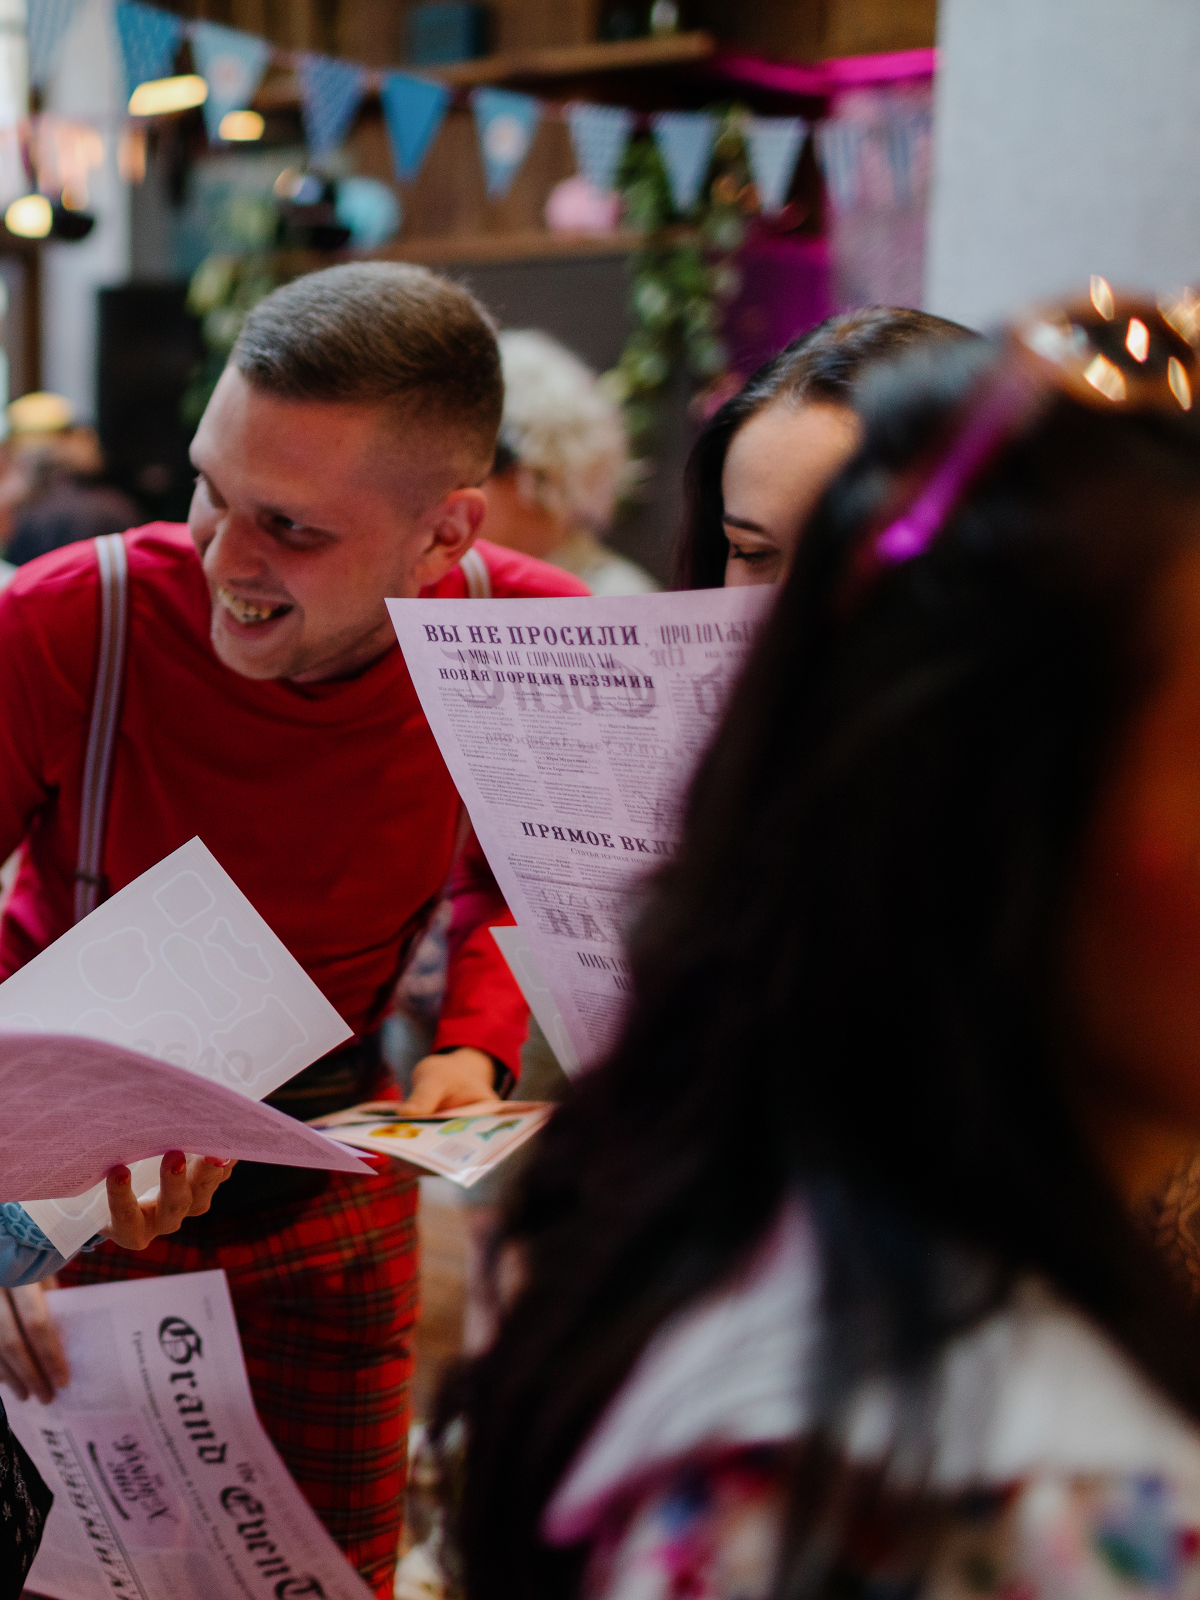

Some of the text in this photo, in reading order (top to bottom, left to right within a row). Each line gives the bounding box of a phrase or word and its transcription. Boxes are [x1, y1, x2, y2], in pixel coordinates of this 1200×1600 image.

[422, 624, 462, 643] ВЫ
[466, 625, 502, 644] НЕ
[468, 649, 490, 665] МЫ
[492, 650, 503, 665] И
[506, 650, 521, 666] НЕ
[437, 668, 655, 689] НОВАЯ ПОРЦИЯ БЕЗУМИЯ
[520, 821, 615, 849] ПРЯМОЕ
[157, 1316, 227, 1464] Grand
